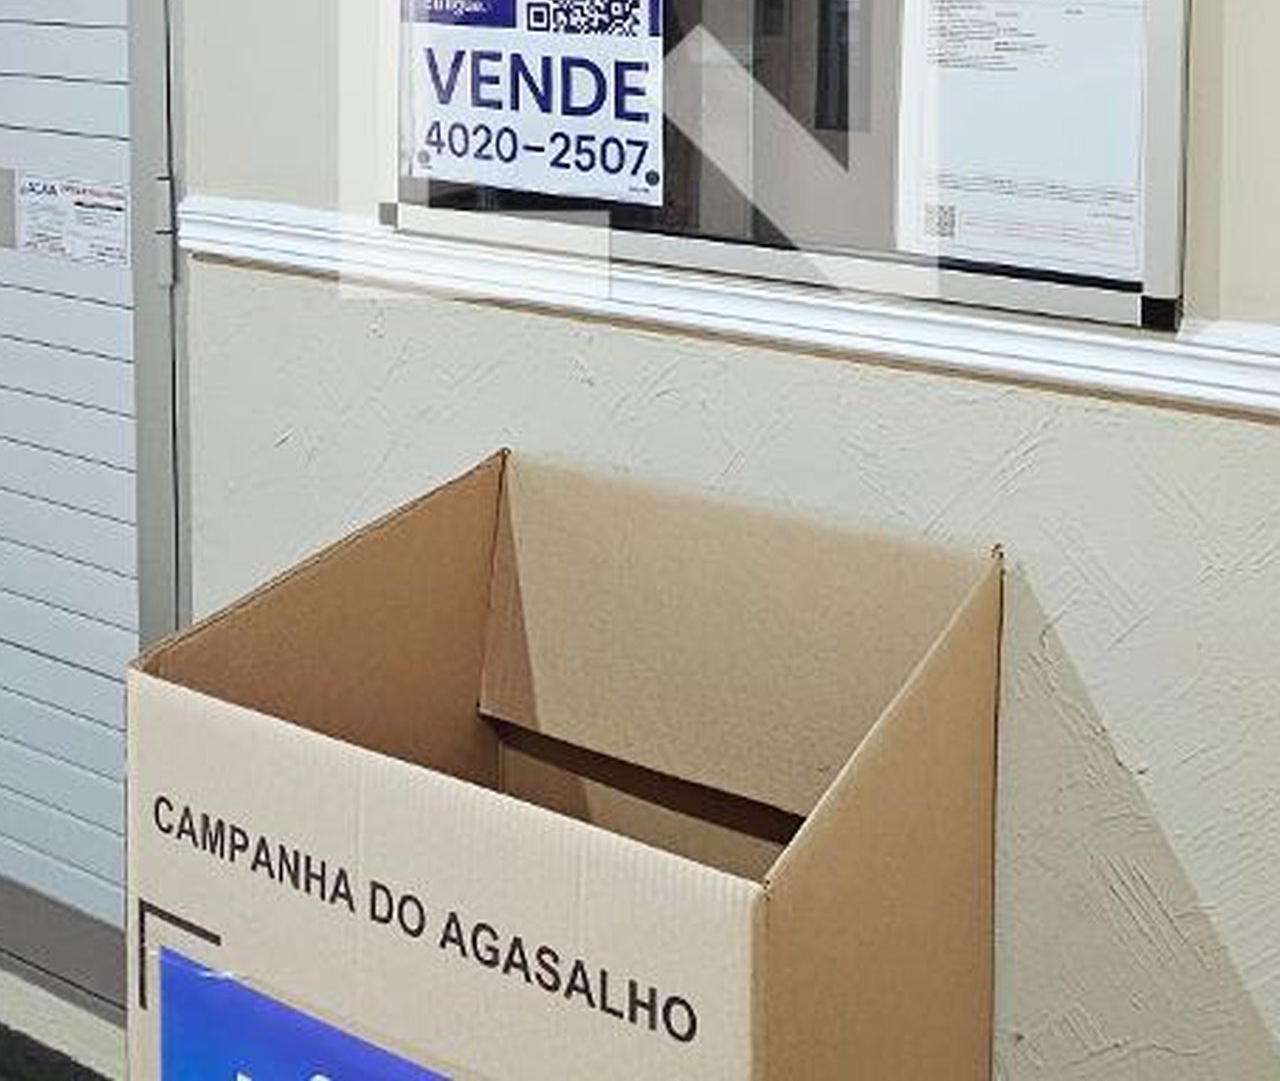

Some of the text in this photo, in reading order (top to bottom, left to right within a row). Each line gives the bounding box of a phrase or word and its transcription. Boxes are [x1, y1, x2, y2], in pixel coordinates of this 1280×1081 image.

[426, 46, 651, 125] VENDE
[424, 121, 650, 177] 4020-2507
[154, 795, 698, 1045] CAMPANHA DO AGASALHO
